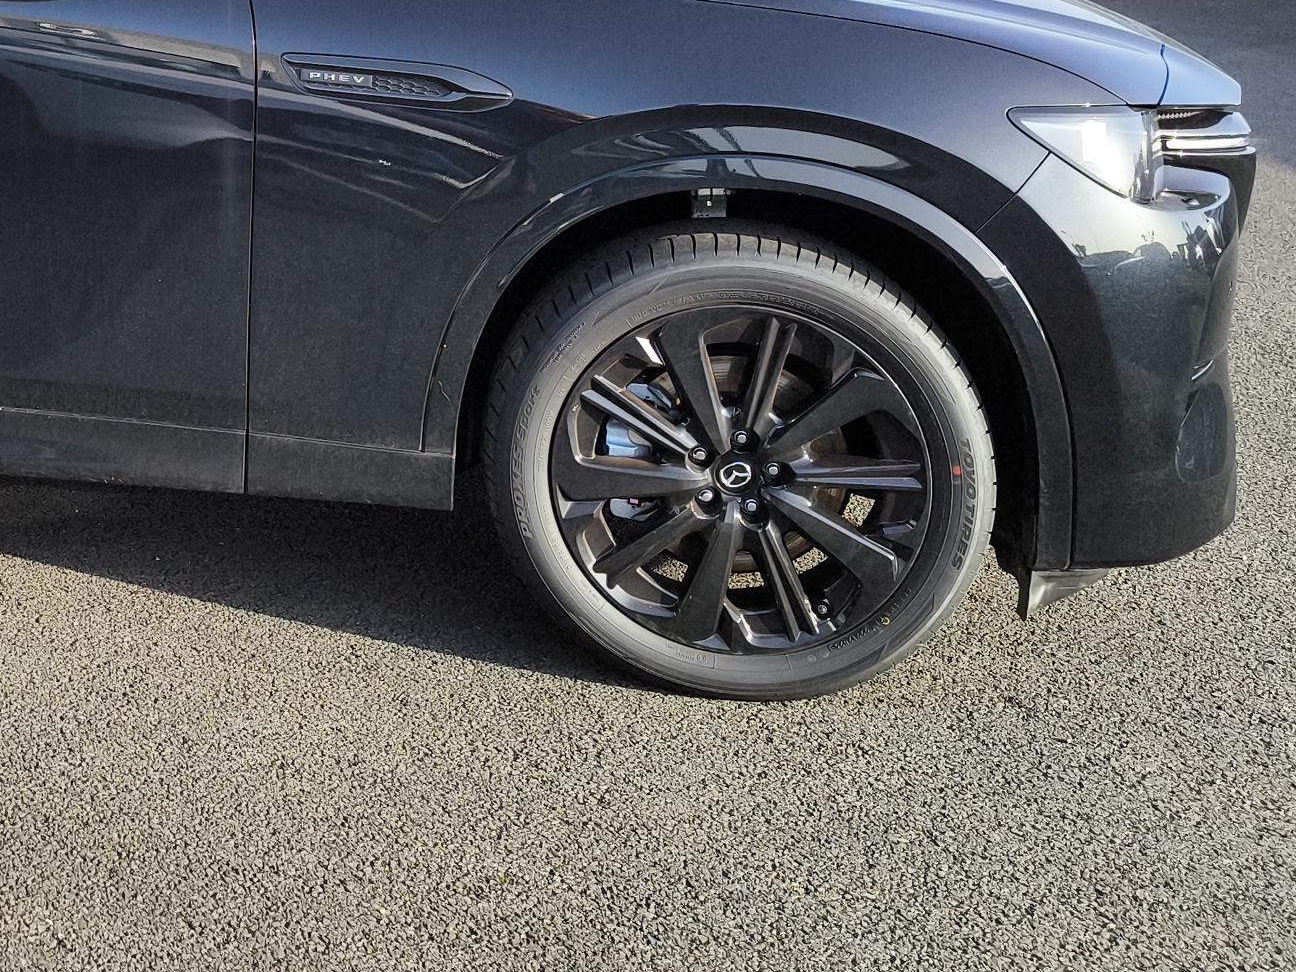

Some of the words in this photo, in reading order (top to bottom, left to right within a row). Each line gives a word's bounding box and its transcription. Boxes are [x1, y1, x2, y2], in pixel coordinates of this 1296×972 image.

[309, 72, 365, 84] PHEV
[512, 444, 534, 540] PROXES
[961, 437, 977, 500] TOYO
[952, 504, 975, 571] TIRES
